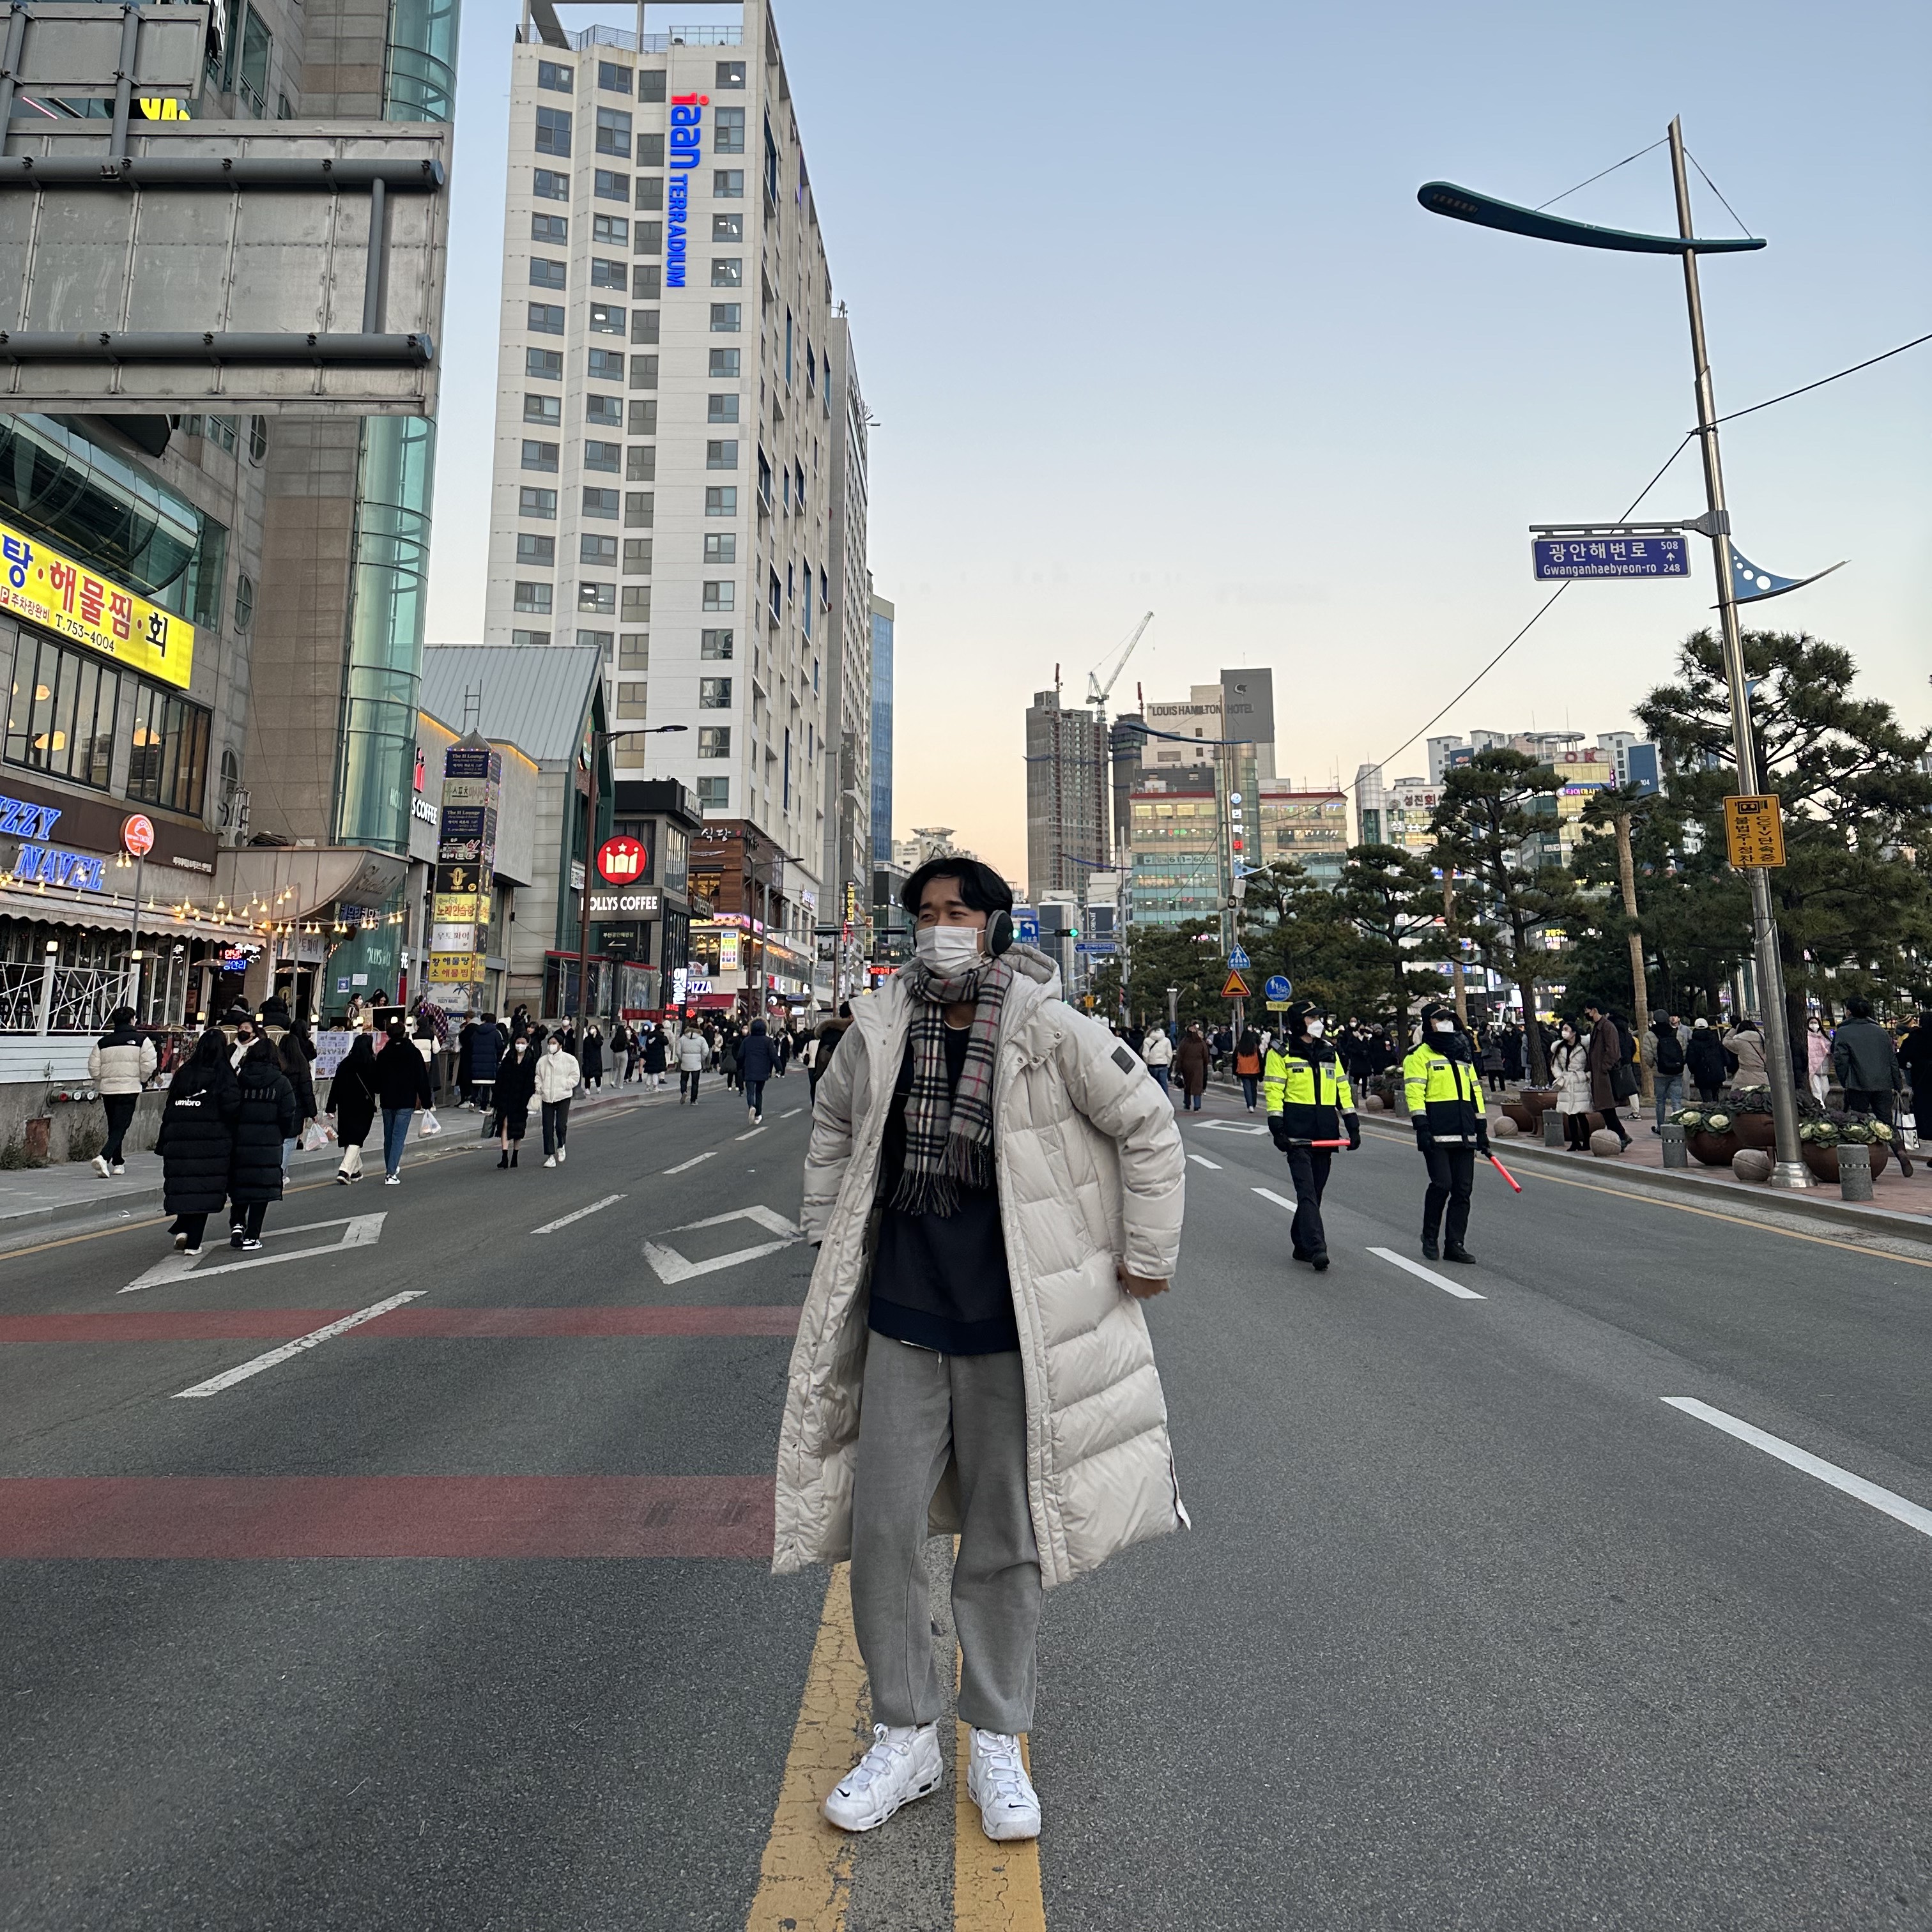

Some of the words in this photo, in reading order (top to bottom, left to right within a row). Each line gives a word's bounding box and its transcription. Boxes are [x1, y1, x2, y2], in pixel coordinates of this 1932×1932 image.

[670, 92, 709, 169] iaan
[666, 173, 688, 288] TERRADIUM
[1549, 543, 1648, 562] 광안해변로
[1661, 541, 1679, 549] 508
[1544, 564, 1657, 576] Gwanganhaebyeon-ro
[1663, 564, 1681, 572] 248
[11, 593, 50, 624] 주차장완비
[55, 613, 116, 653] T.753-4004
[1153, 705, 1177, 716] LOUIS
[1227, 703, 1254, 714] HOTEL
[0, 795, 62, 841] ZZY
[416, 799, 438, 825] COFFEE
[701, 827, 732, 843] 식당
[14, 844, 103, 891] NAVEL
[1169, 855, 1217, 864] 611-6001
[620, 896, 657, 910] COFFEE
[687, 981, 712, 994] PIZZA
[175, 1098, 201, 1107] umbro
